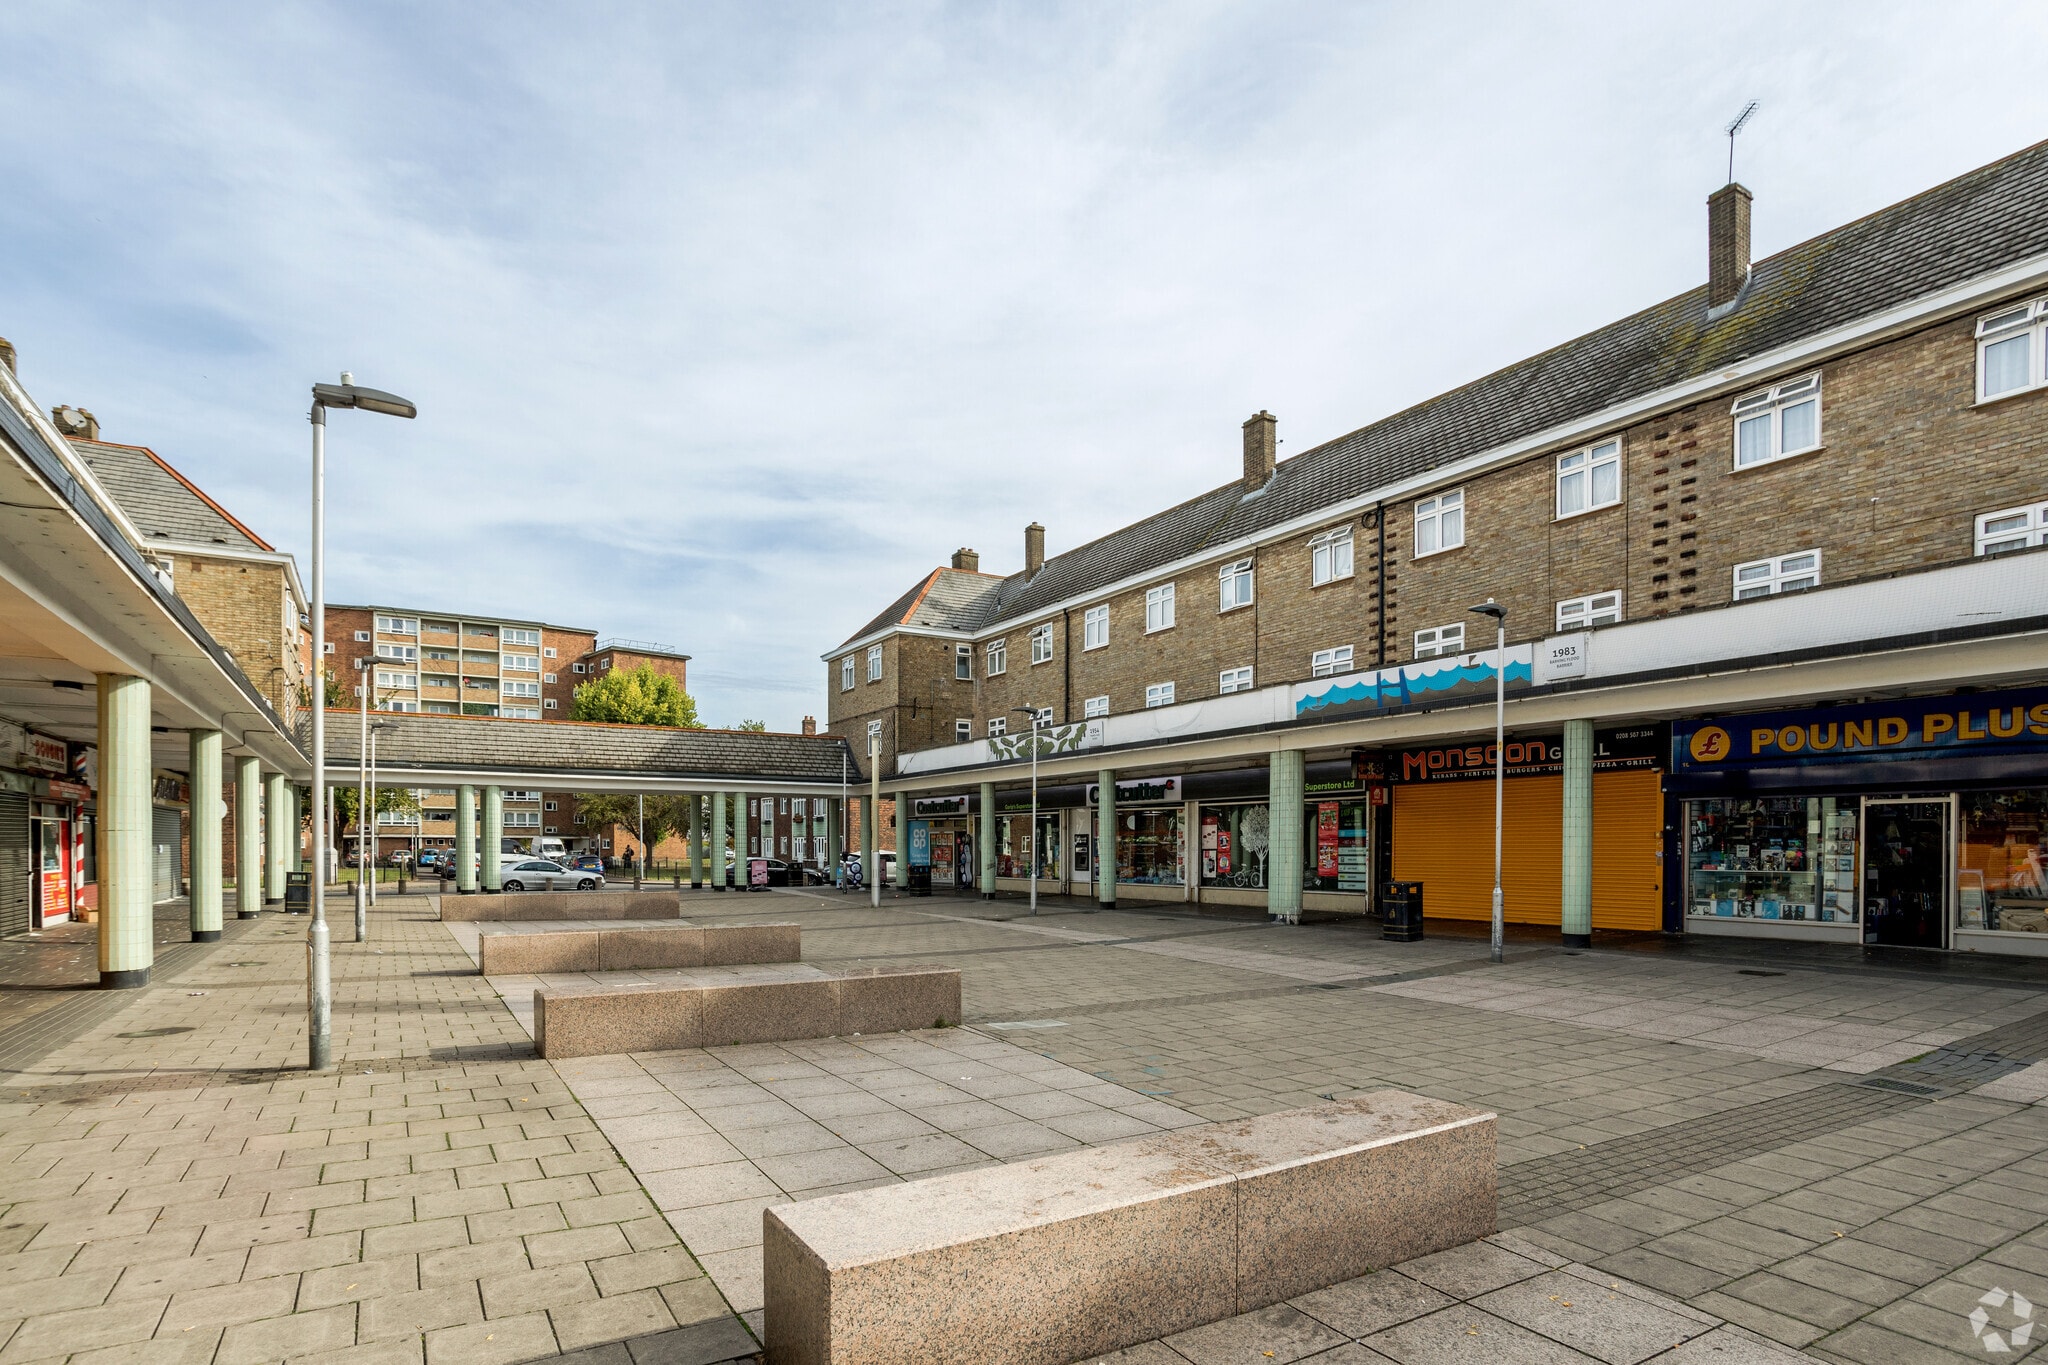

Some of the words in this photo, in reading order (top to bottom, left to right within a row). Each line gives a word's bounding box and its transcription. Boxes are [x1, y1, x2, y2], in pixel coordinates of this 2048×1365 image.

[1552, 646, 1576, 657] 1983
[1751, 716, 1908, 754] POUND
[1922, 703, 2048, 742] PLUS
[1482, 769, 1497, 777] PER
[1506, 766, 1541, 774] BURGERS
[1089, 782, 1166, 803] Ctcutter
[1304, 782, 1342, 792] Superstore
[1343, 780, 1355, 789] Ltd
[917, 799, 959, 814] Costcutter
